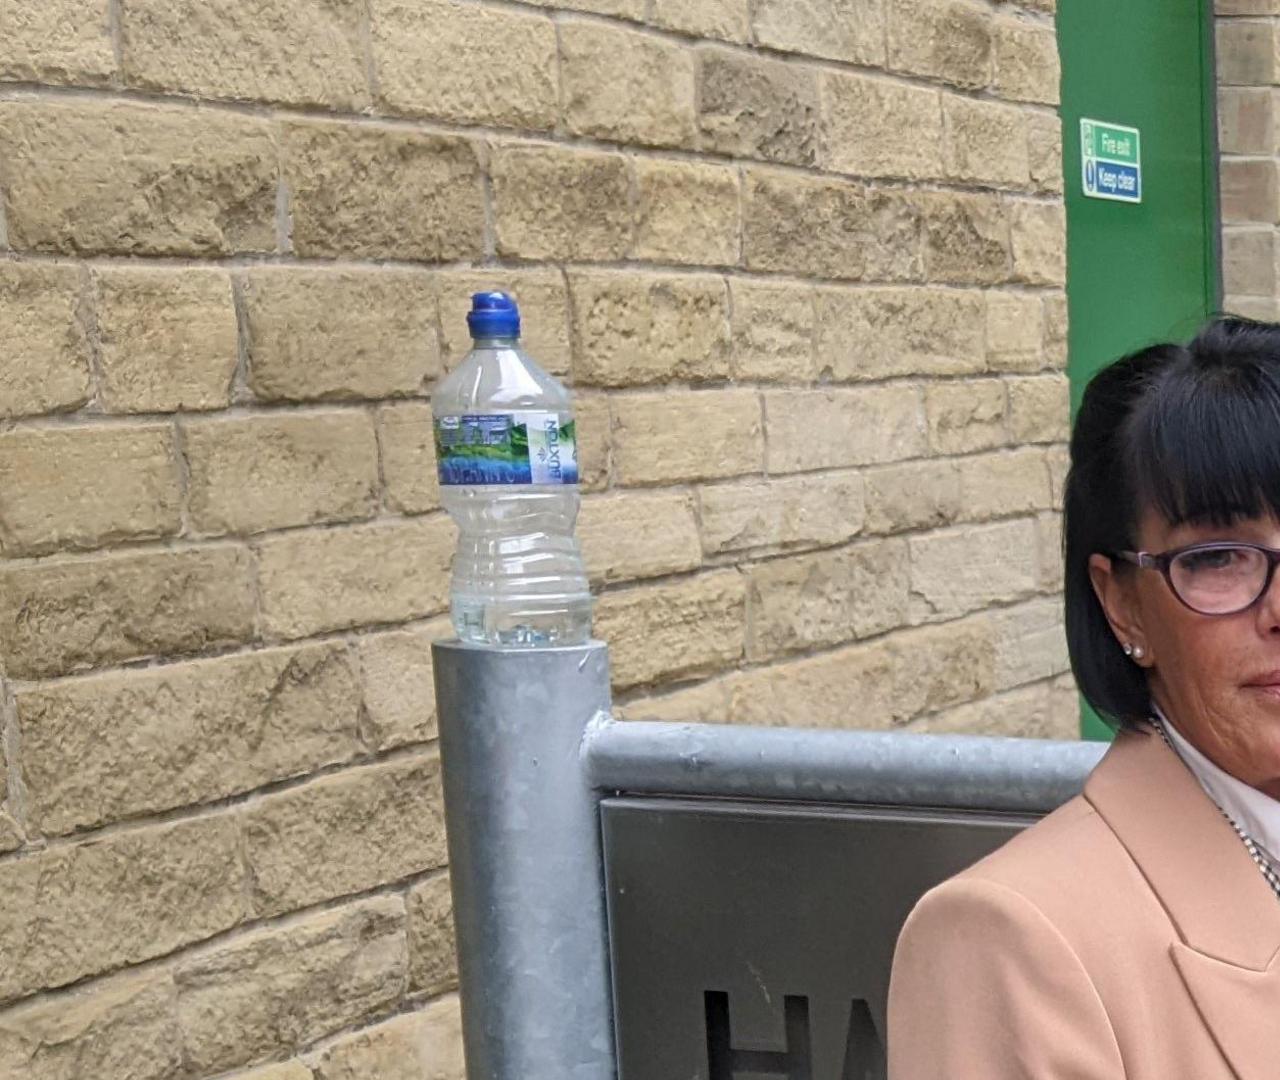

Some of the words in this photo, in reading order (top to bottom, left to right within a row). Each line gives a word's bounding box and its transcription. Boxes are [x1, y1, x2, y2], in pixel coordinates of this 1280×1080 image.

[1101, 132, 1116, 155] Fire
[1098, 167, 1117, 193] Keep
[1117, 170, 1136, 191] clear
[547, 419, 562, 480] BUXTON
